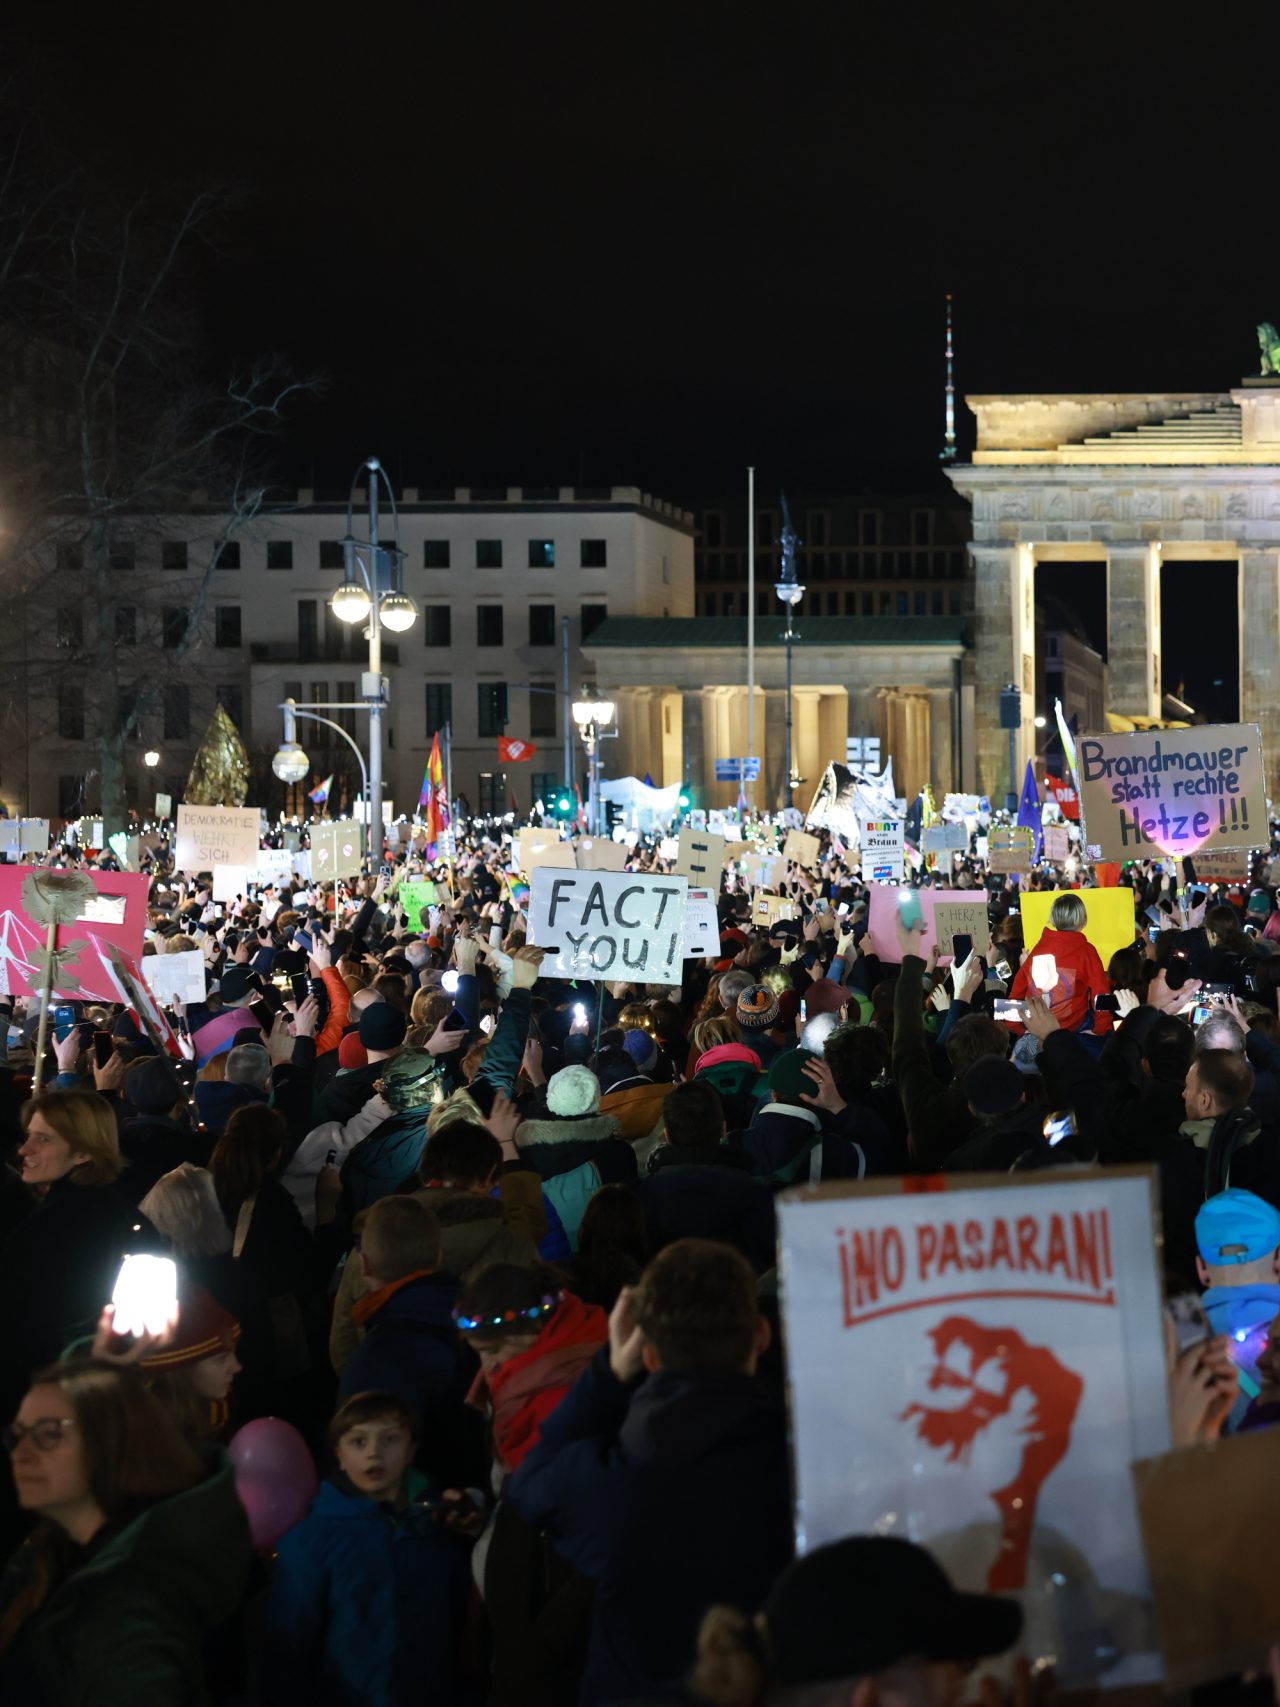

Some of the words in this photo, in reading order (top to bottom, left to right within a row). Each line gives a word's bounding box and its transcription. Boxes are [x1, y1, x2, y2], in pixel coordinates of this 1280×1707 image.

[1081, 740, 1248, 782] Brandmauer
[1111, 774, 1161, 804] statt
[1173, 769, 1240, 797] rechte
[1056, 787, 1077, 803] DIE
[184, 813, 254, 829] DEMOKRATIE
[866, 822, 899, 831] BUNT
[193, 830, 241, 847] WEHRT
[867, 838, 897, 846] Braun
[199, 848, 230, 861] SICH
[548, 879, 680, 930] FACT
[949, 908, 975, 921] HERZ
[916, 1209, 1115, 1298] PASARAN!
